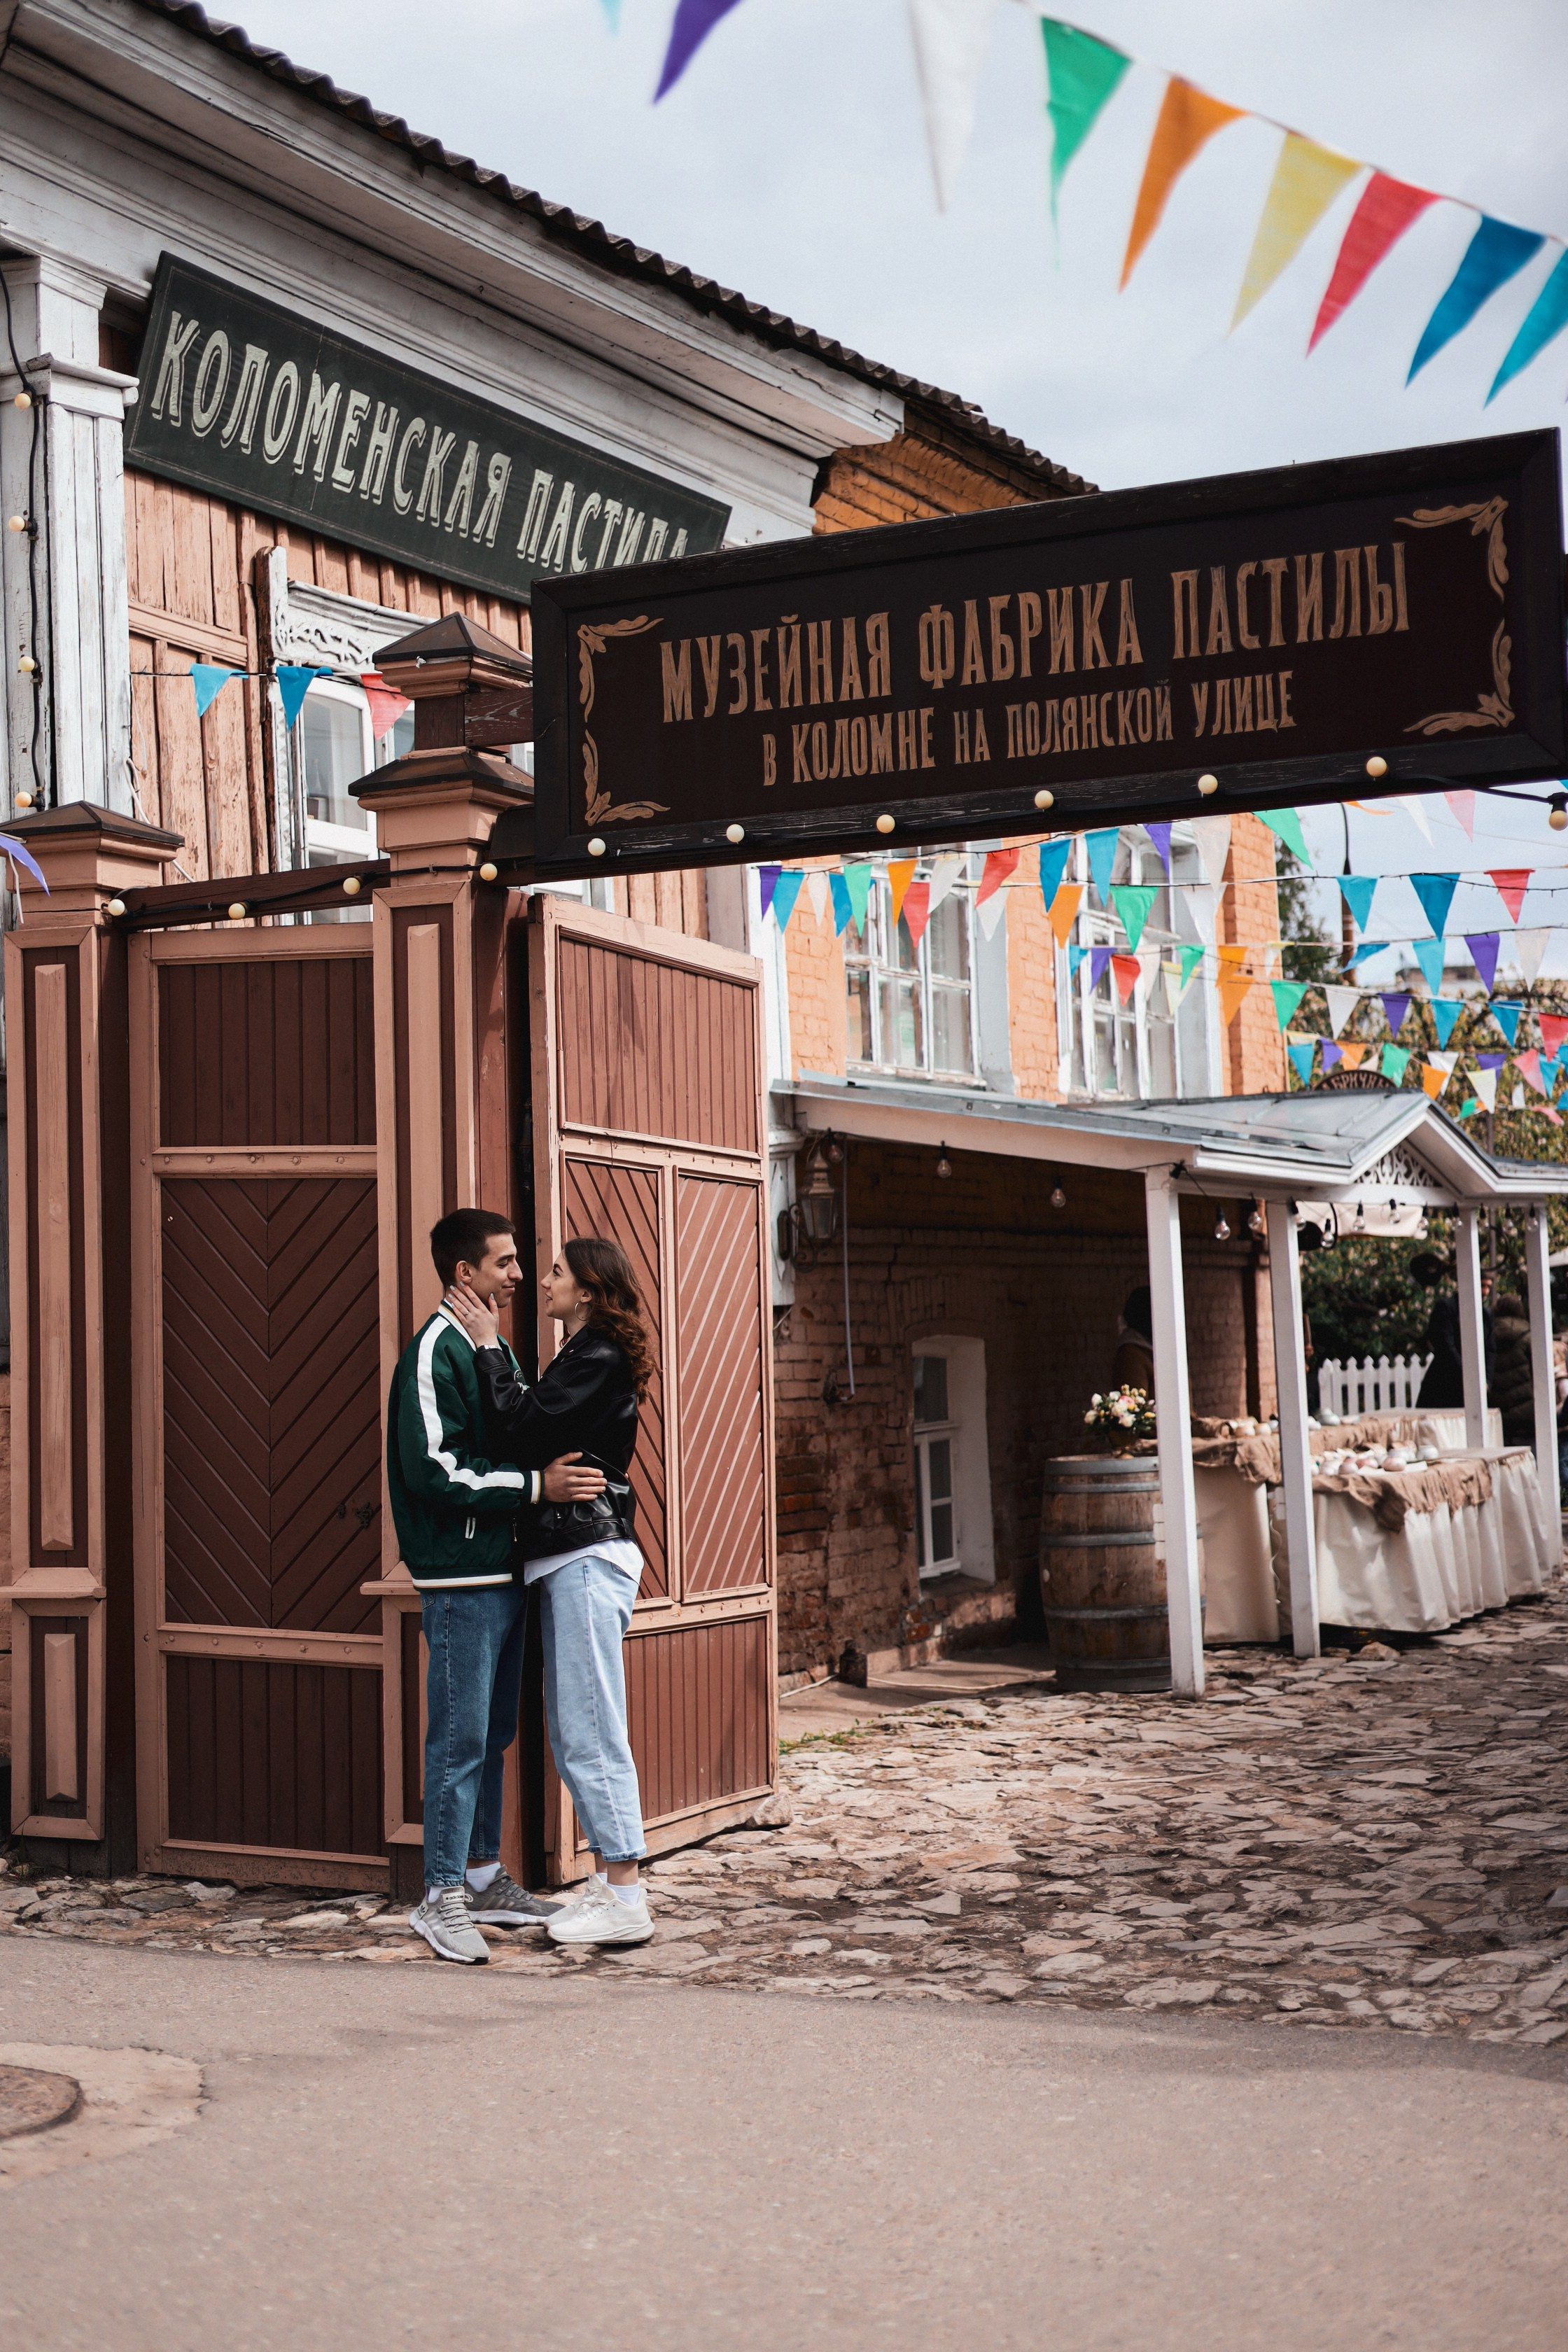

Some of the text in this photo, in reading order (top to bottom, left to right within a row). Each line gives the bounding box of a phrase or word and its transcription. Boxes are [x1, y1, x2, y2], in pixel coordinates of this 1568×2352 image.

[151, 311, 512, 548] КОЛОМЕНСКАЯ
[660, 542, 1410, 724] МУЗЕЙНАЯ ФАБРИКА ПАСТИЛЫ
[763, 671, 1297, 786] В КОЛОМНЕ НА ПОЛЯНСКОЙ УЛИЦЕ
